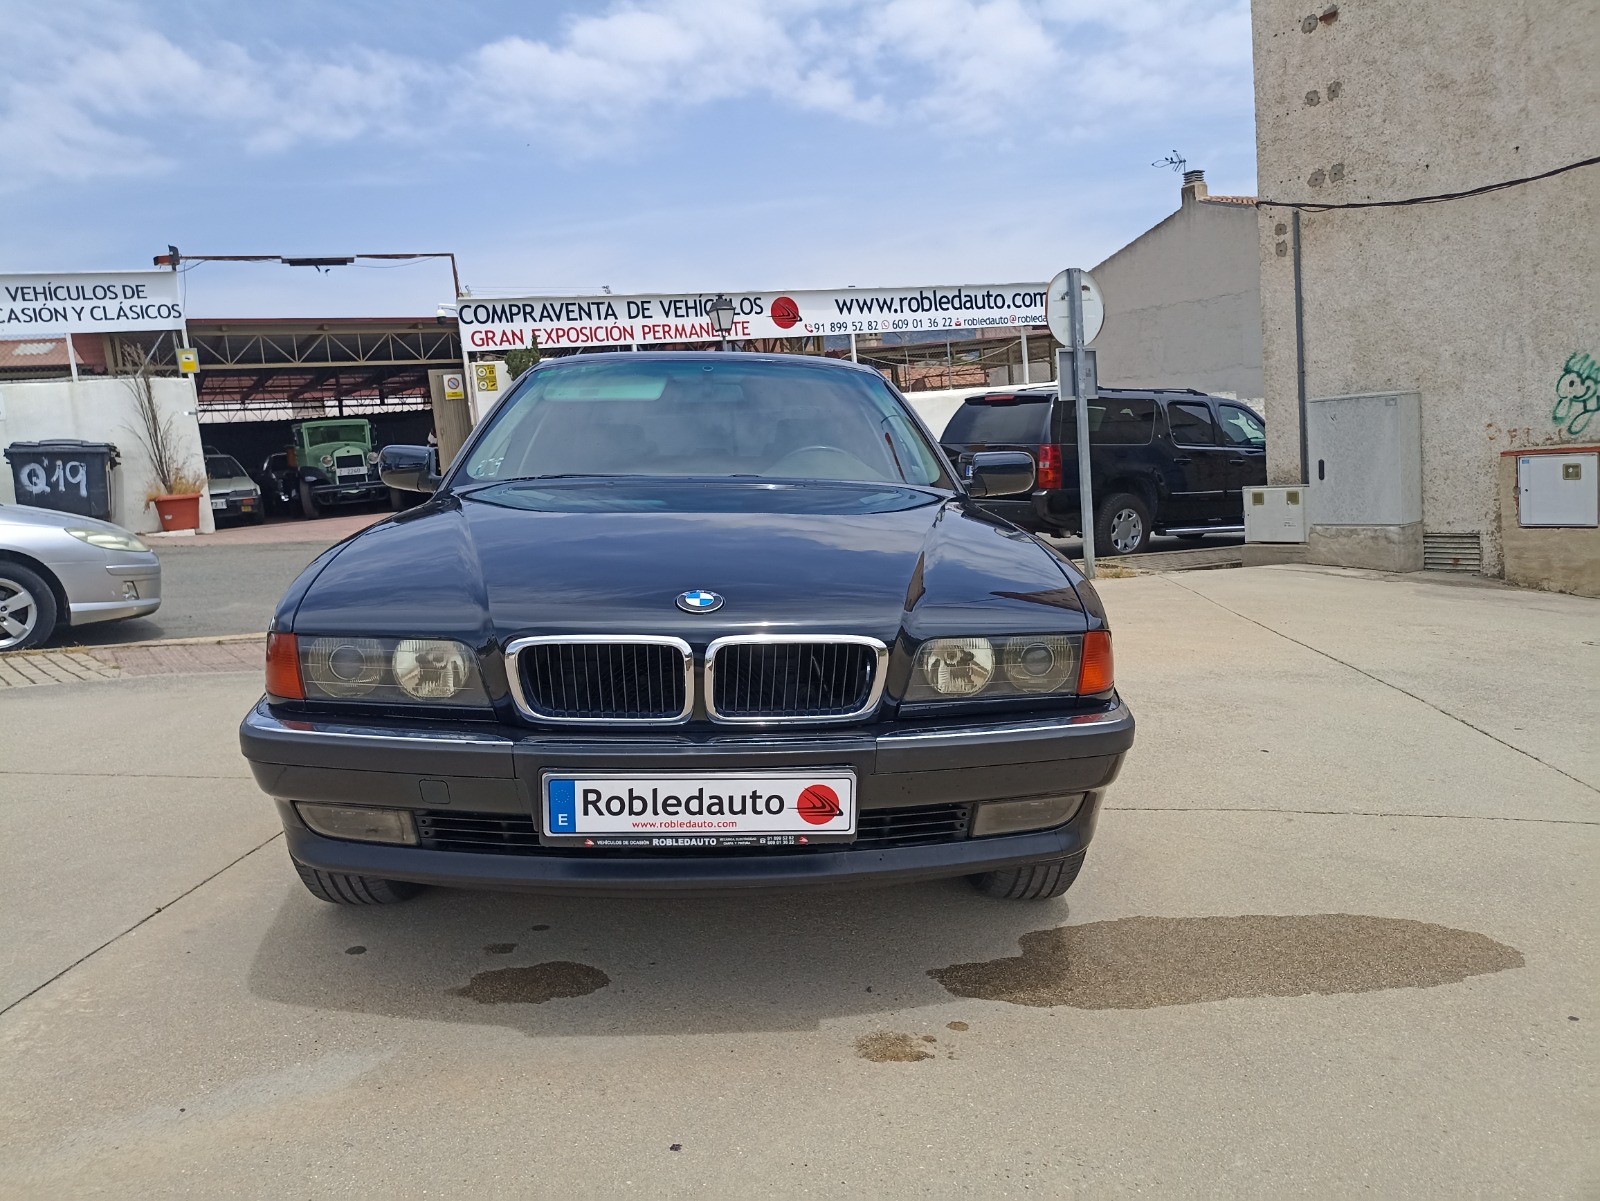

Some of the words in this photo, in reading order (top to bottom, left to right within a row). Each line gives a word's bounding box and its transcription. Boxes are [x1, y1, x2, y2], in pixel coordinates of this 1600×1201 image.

[5, 282, 118, 302] VEHÍCULOS
[122, 284, 148, 300] DE
[71, 306, 85, 322] Y
[89, 301, 182, 321] CLÁSICOS
[458, 302, 618, 325] COMPRAVENTA
[626, 300, 653, 320] DE
[470, 329, 525, 347] GRAN
[531, 321, 635, 345] EXPOSICIÓN
[641, 321, 751, 341] PERMANETE
[814, 323, 826, 333] 91
[830, 321, 848, 332] 899
[851, 320, 864, 332] 52
[867, 320, 879, 331] 82
[892, 319, 909, 330] 609
[912, 318, 923, 329] 01
[927, 317, 939, 328] 36
[942, 316, 953, 327] 22
[582, 787, 785, 816] Robledauto
[558, 813, 568, 826] E
[631, 819, 737, 829] www.robledauto.com
[652, 838, 717, 846] ROBLEDAUTO
